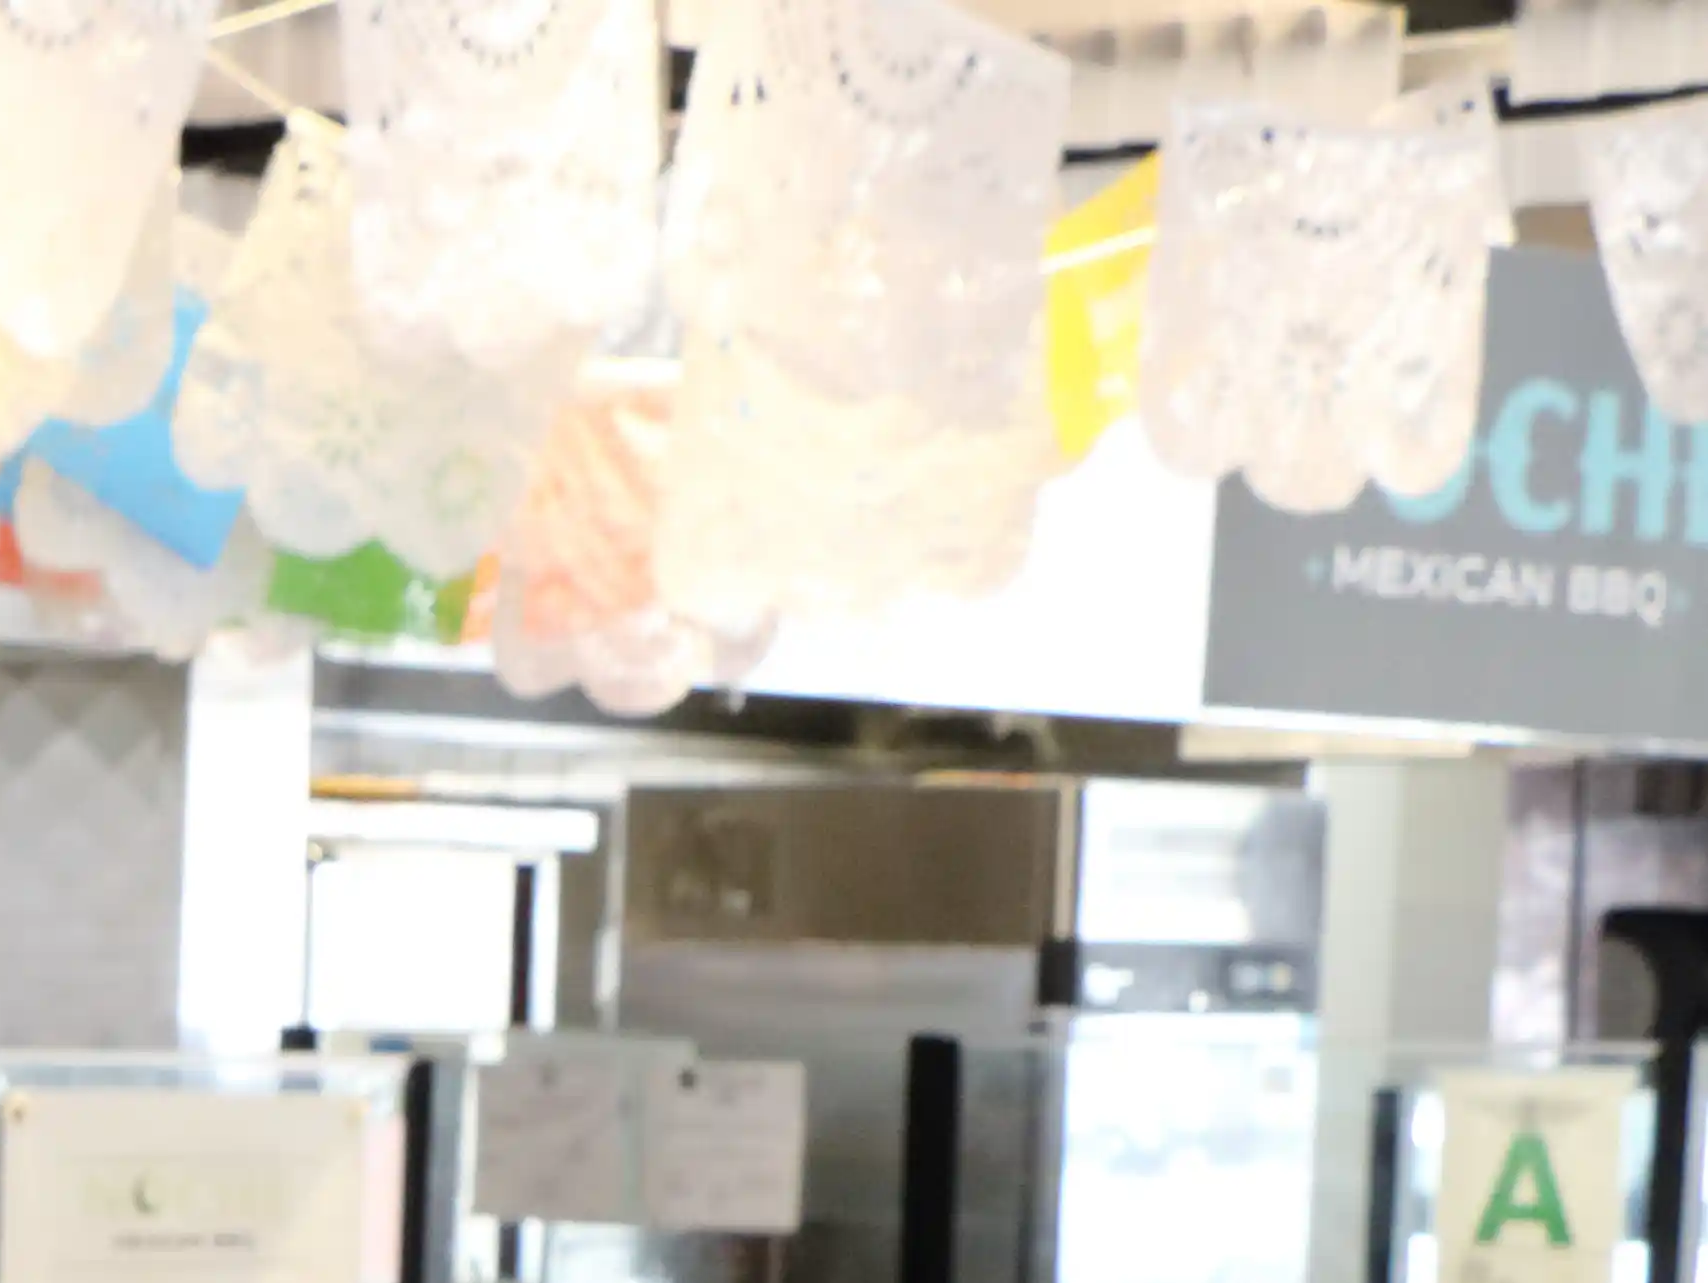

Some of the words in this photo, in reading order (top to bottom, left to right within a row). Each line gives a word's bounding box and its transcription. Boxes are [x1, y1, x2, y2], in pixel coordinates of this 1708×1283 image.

[1331, 545, 1555, 609] MEXICAN
[1567, 564, 1668, 628] BBQ
[1475, 1130, 1572, 1248] A
